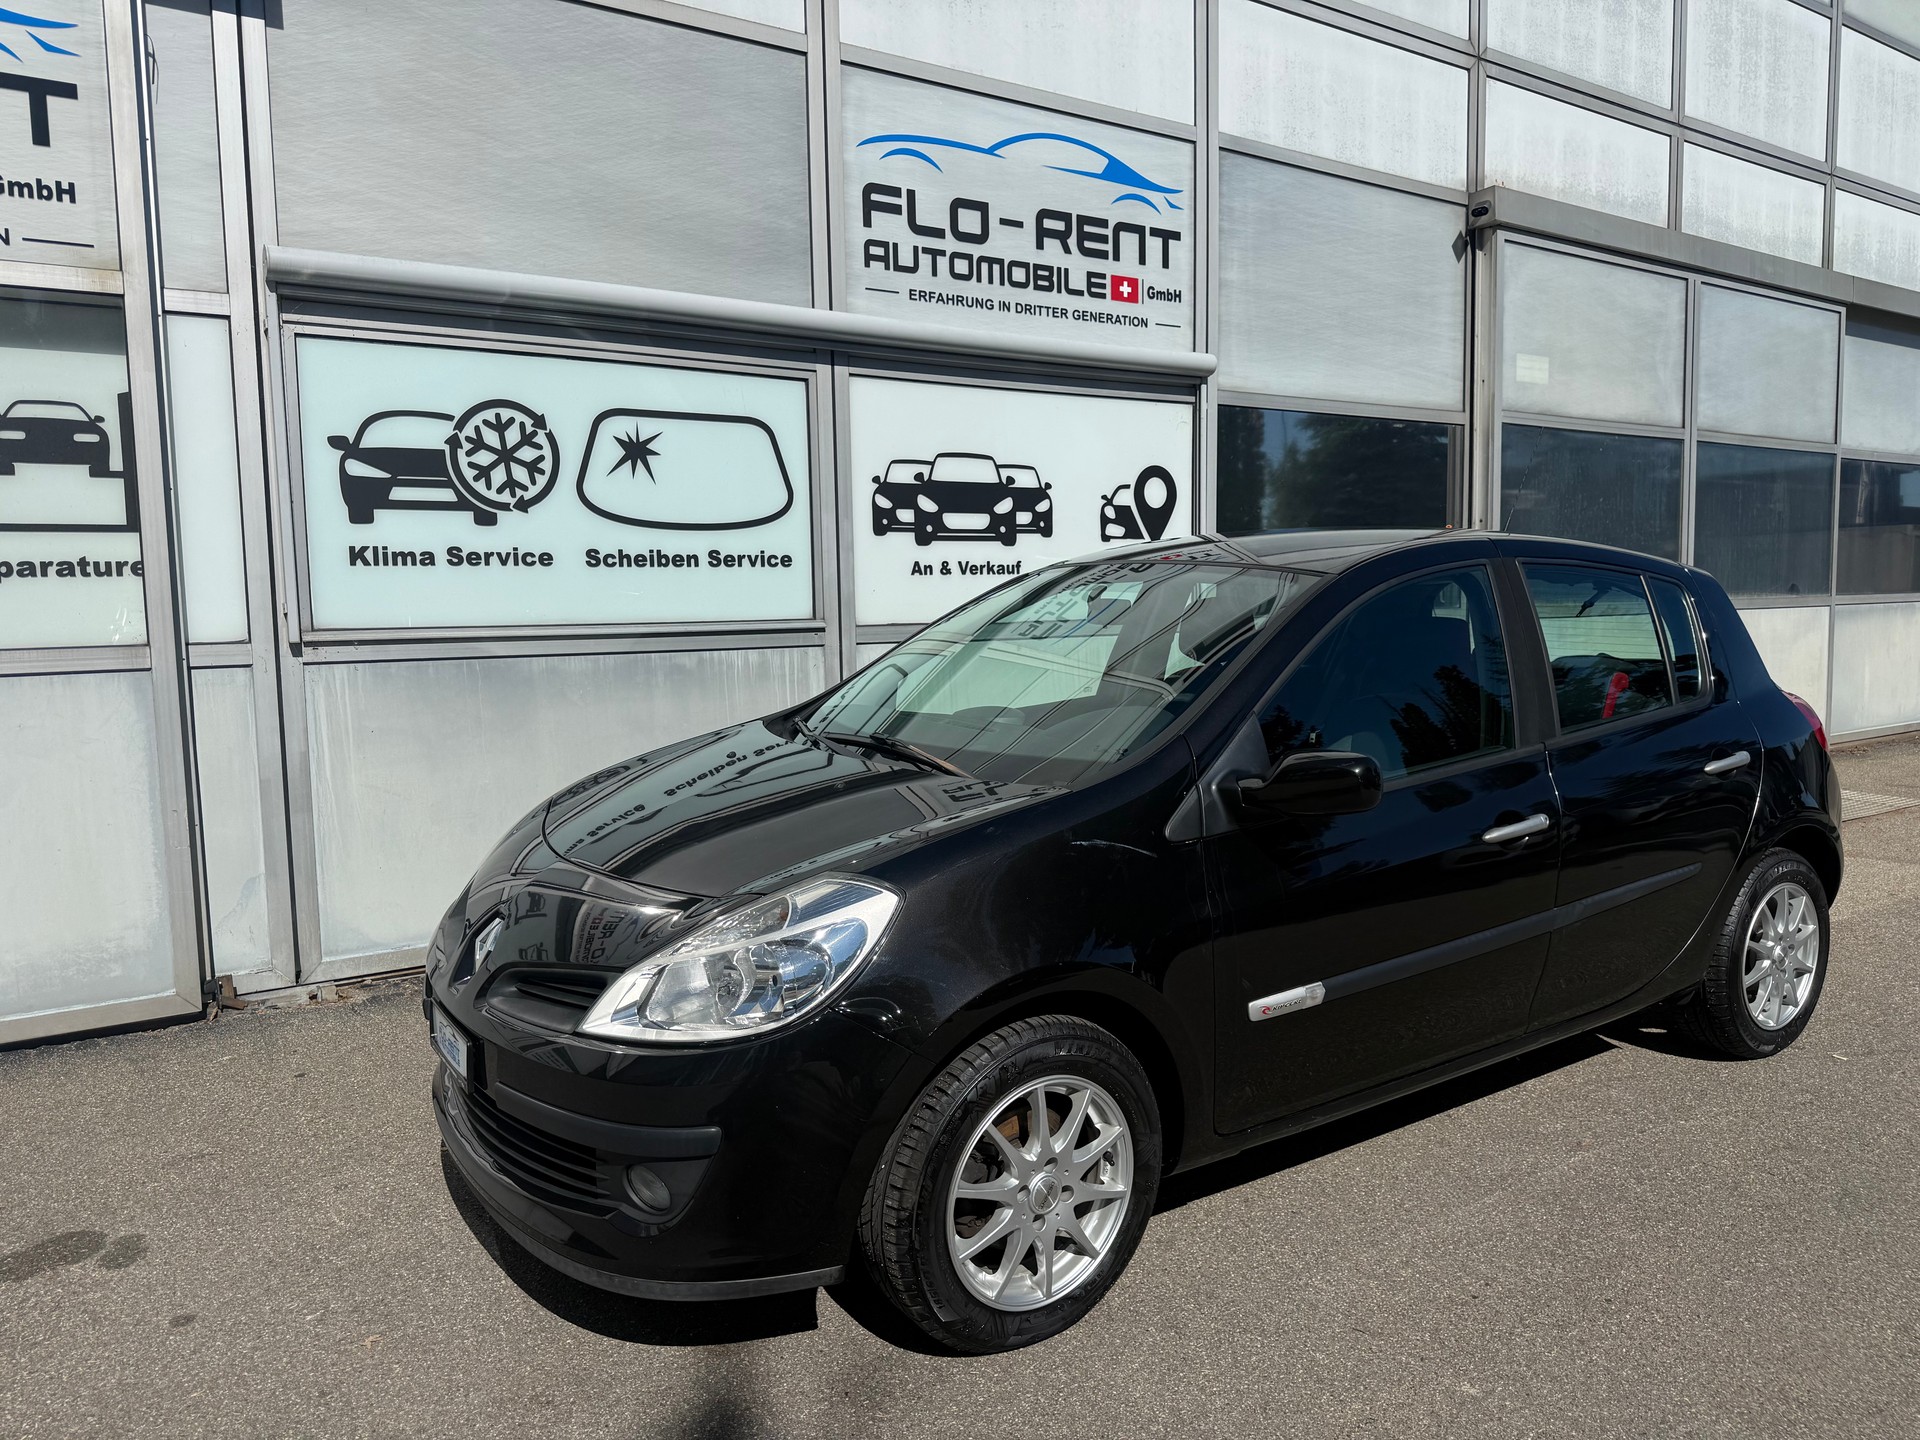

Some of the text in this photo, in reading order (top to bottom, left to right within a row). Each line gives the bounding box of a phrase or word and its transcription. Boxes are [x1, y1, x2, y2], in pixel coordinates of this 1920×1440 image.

[0, 175, 76, 204] mbH
[862, 182, 1181, 269] FLO-RENT
[864, 239, 1182, 303] AUTOMOBILE GmbH
[909, 289, 1148, 329] ERFAHRUNG IN DRITTER GENERATION
[348, 546, 554, 566] Klima Service
[585, 549, 793, 567] Scheiben Service
[911, 561, 1022, 575] An & Verkauf
